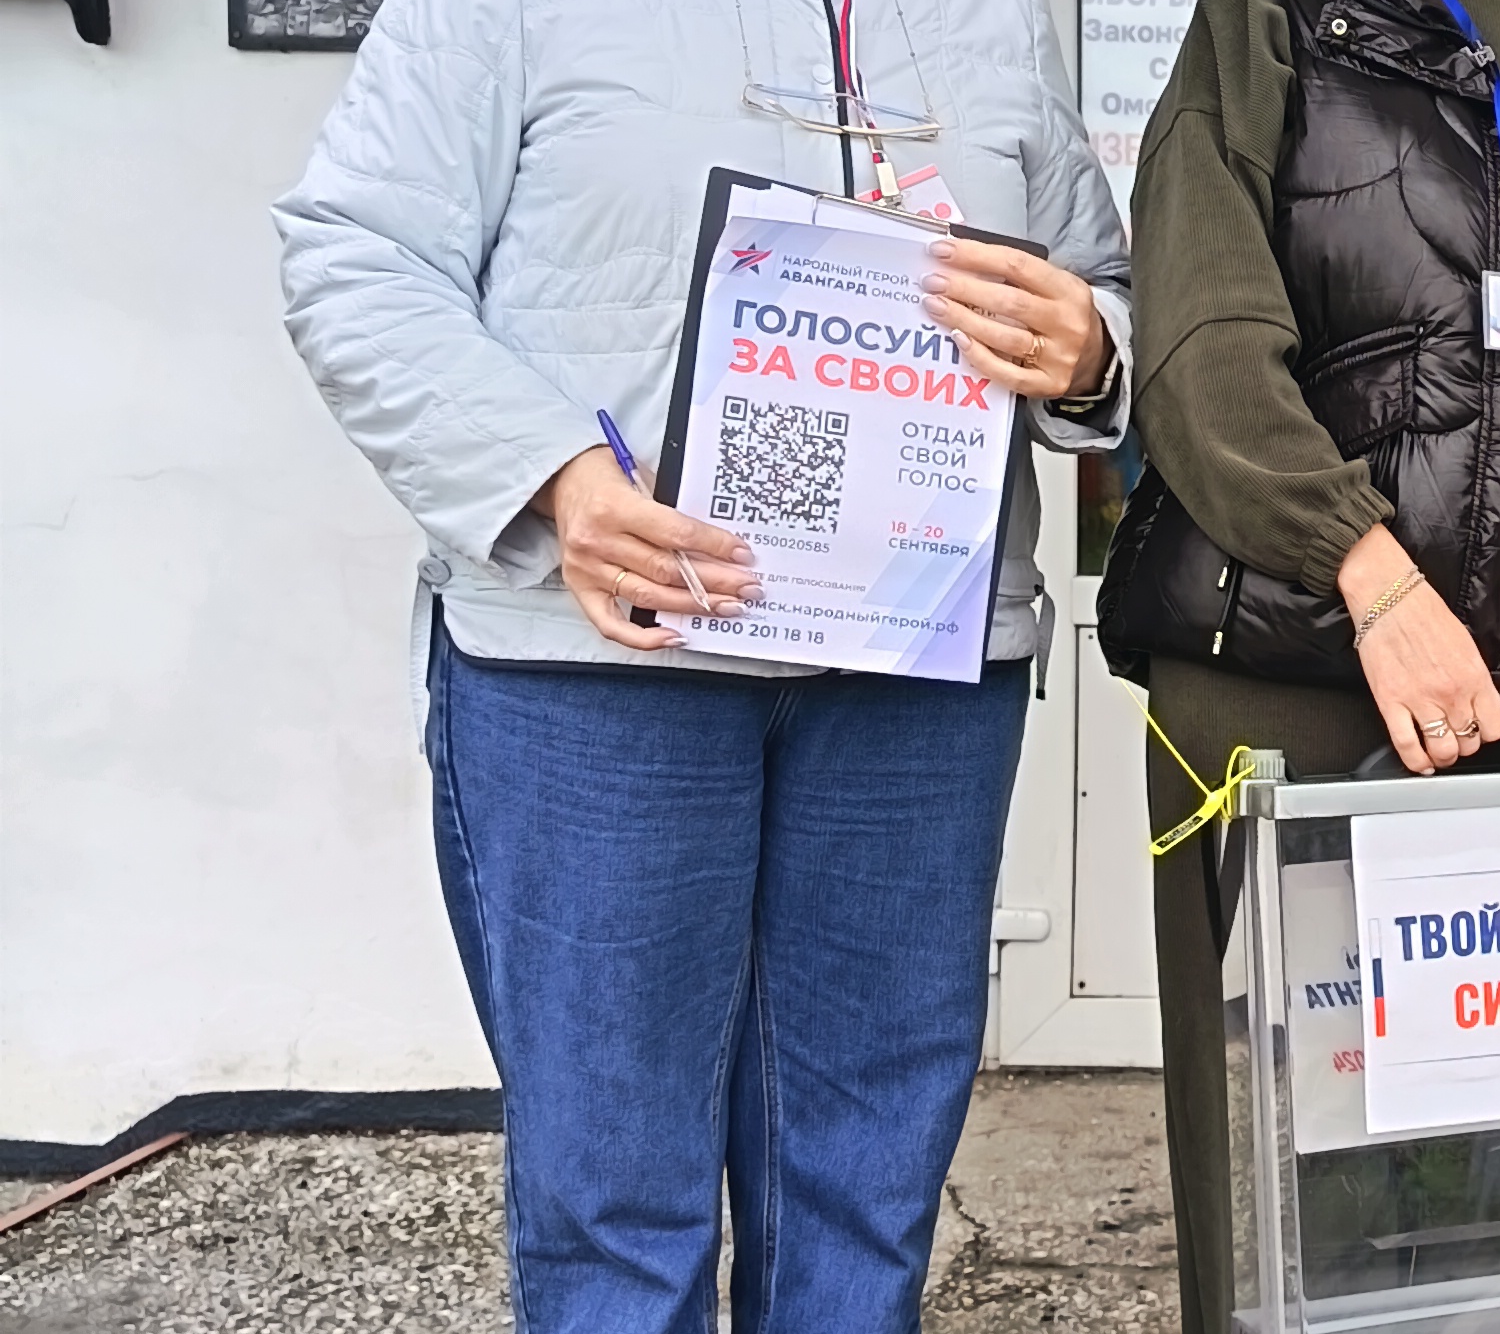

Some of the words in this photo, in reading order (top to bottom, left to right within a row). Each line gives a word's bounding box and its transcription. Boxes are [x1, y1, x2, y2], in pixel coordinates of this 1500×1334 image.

[1084, 17, 1187, 43] Законо
[782, 254, 862, 278] НАРОДНЫЙ
[866, 269, 910, 286] ГЕРОЙ
[780, 269, 867, 297] АВАНГАРД
[872, 287, 920, 305] ОМСКО
[733, 299, 963, 365] ГОЛОСУЙТ
[728, 337, 798, 382] ЗА
[813, 353, 992, 412] СВОИХ
[901, 421, 985, 449] ОТДАЙ
[899, 445, 967, 470] СВОЙ
[897, 468, 980, 495] ГОЛОС
[889, 520, 907, 535] 18
[923, 525, 945, 539] 20
[753, 533, 831, 555] 550020585
[888, 536, 971, 558] СЕНТЯБРЯ
[768, 573, 788, 584] ДЛЯ
[792, 575, 867, 593] ГОЛОСОВАНИЯ
[743, 598, 960, 635] омск.народныйгерой.рф
[691, 616, 702, 631] 8
[707, 618, 744, 635] 800
[748, 623, 779, 640] 201
[784, 626, 802, 642] 18
[808, 630, 825, 645] 18
